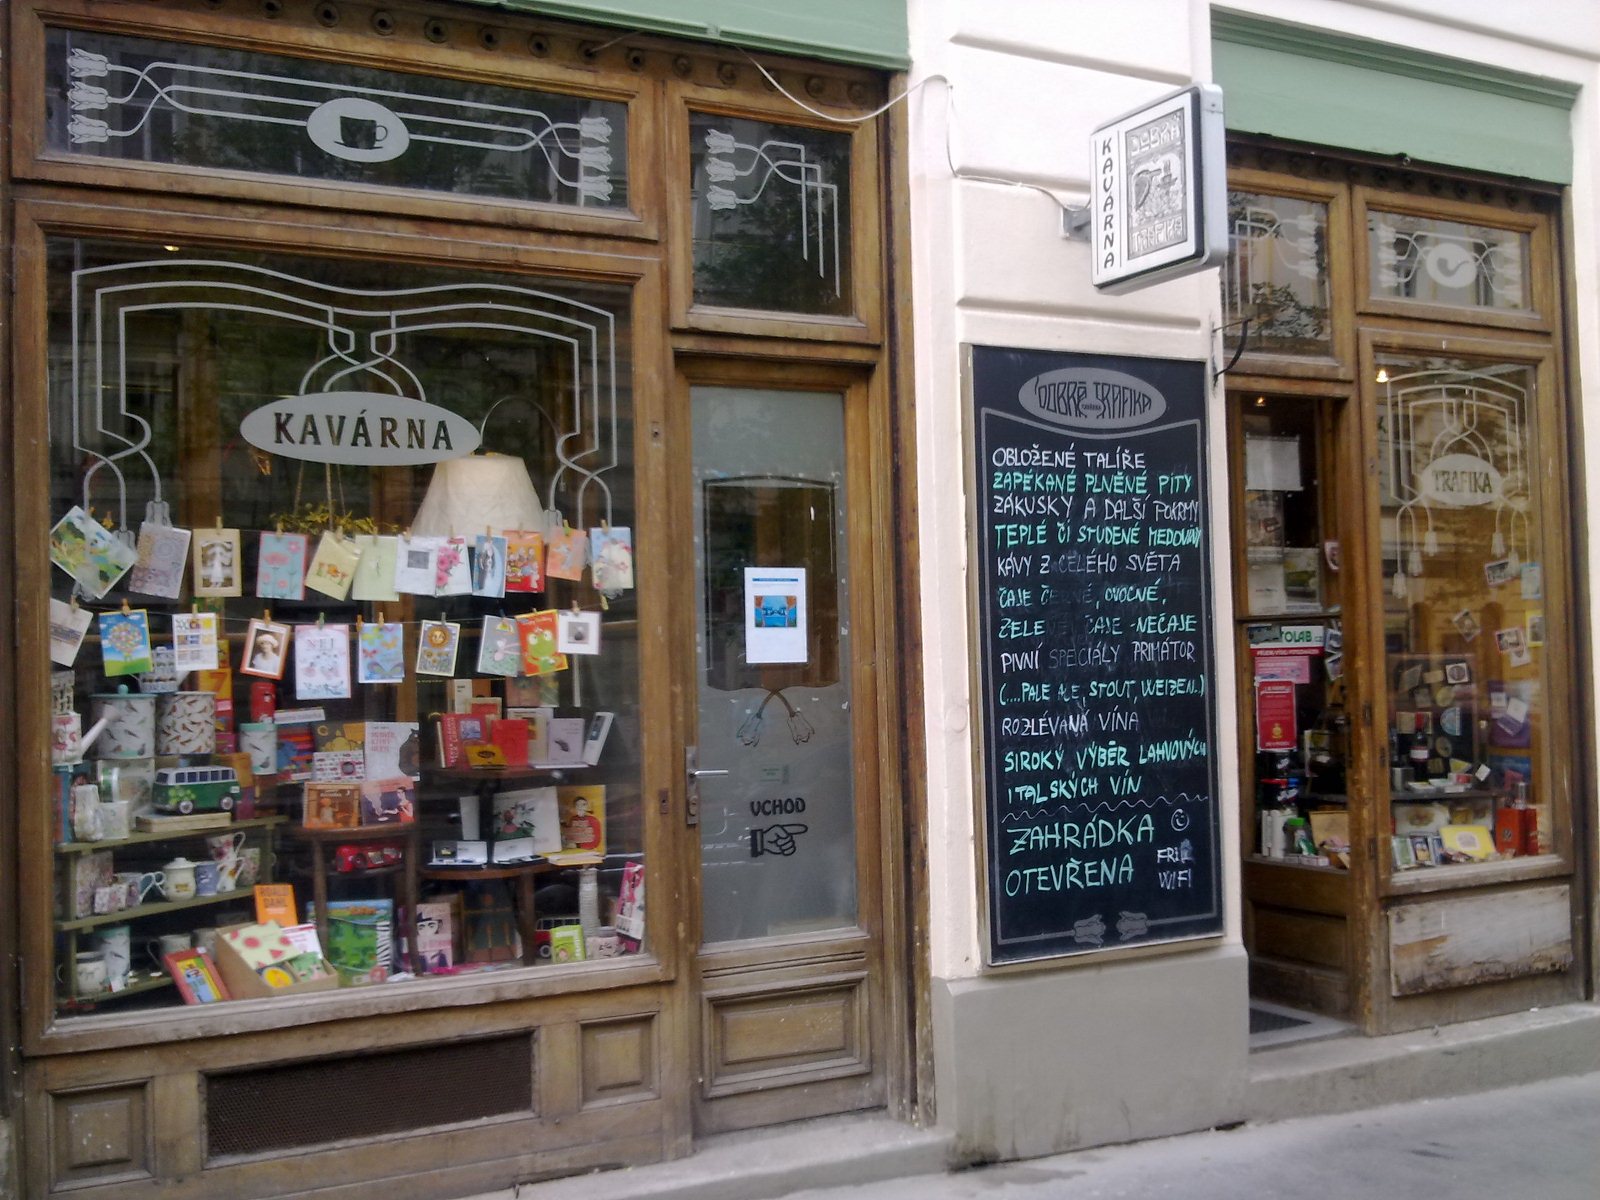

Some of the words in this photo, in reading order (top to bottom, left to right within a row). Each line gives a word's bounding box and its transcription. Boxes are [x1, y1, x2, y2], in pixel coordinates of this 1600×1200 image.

[1093, 381, 1152, 419] TRAFIKA
[274, 409, 453, 450] KAVÁRNA
[992, 443, 1076, 469] OBLOŽENÉ
[1083, 446, 1146, 470] TALÍŘE
[992, 469, 1077, 494] ZAPÉKANÉ
[1085, 471, 1148, 494] PLNĚNÉ
[1431, 469, 1493, 494] TRAFIKA
[993, 494, 1073, 517] ZÁKUSKY
[1084, 498, 1097, 520] A
[1104, 494, 1151, 521] DALŠÍ
[994, 520, 1047, 549] TEPLÉ
[1077, 523, 1140, 546] STUDENÉ
[997, 551, 1032, 578] KÁVY
[1039, 555, 1050, 572] Z
[1058, 548, 1117, 574] CELÉHO
[1126, 551, 1180, 573] SVĚTA
[998, 586, 1032, 609] ČAJE
[1001, 642, 1043, 674] PIVNÍ
[1049, 641, 1121, 669] SPECIÁLY
[1099, 705, 1140, 732] VÍNA
[1076, 740, 1130, 770] VÝBĚR
[1139, 728, 1208, 765] LAHVOVÝCH
[1110, 769, 1142, 796] VÍN
[1007, 813, 1155, 856] ZAHRÁDKA
[1005, 853, 1134, 896] OTEVŘENA
